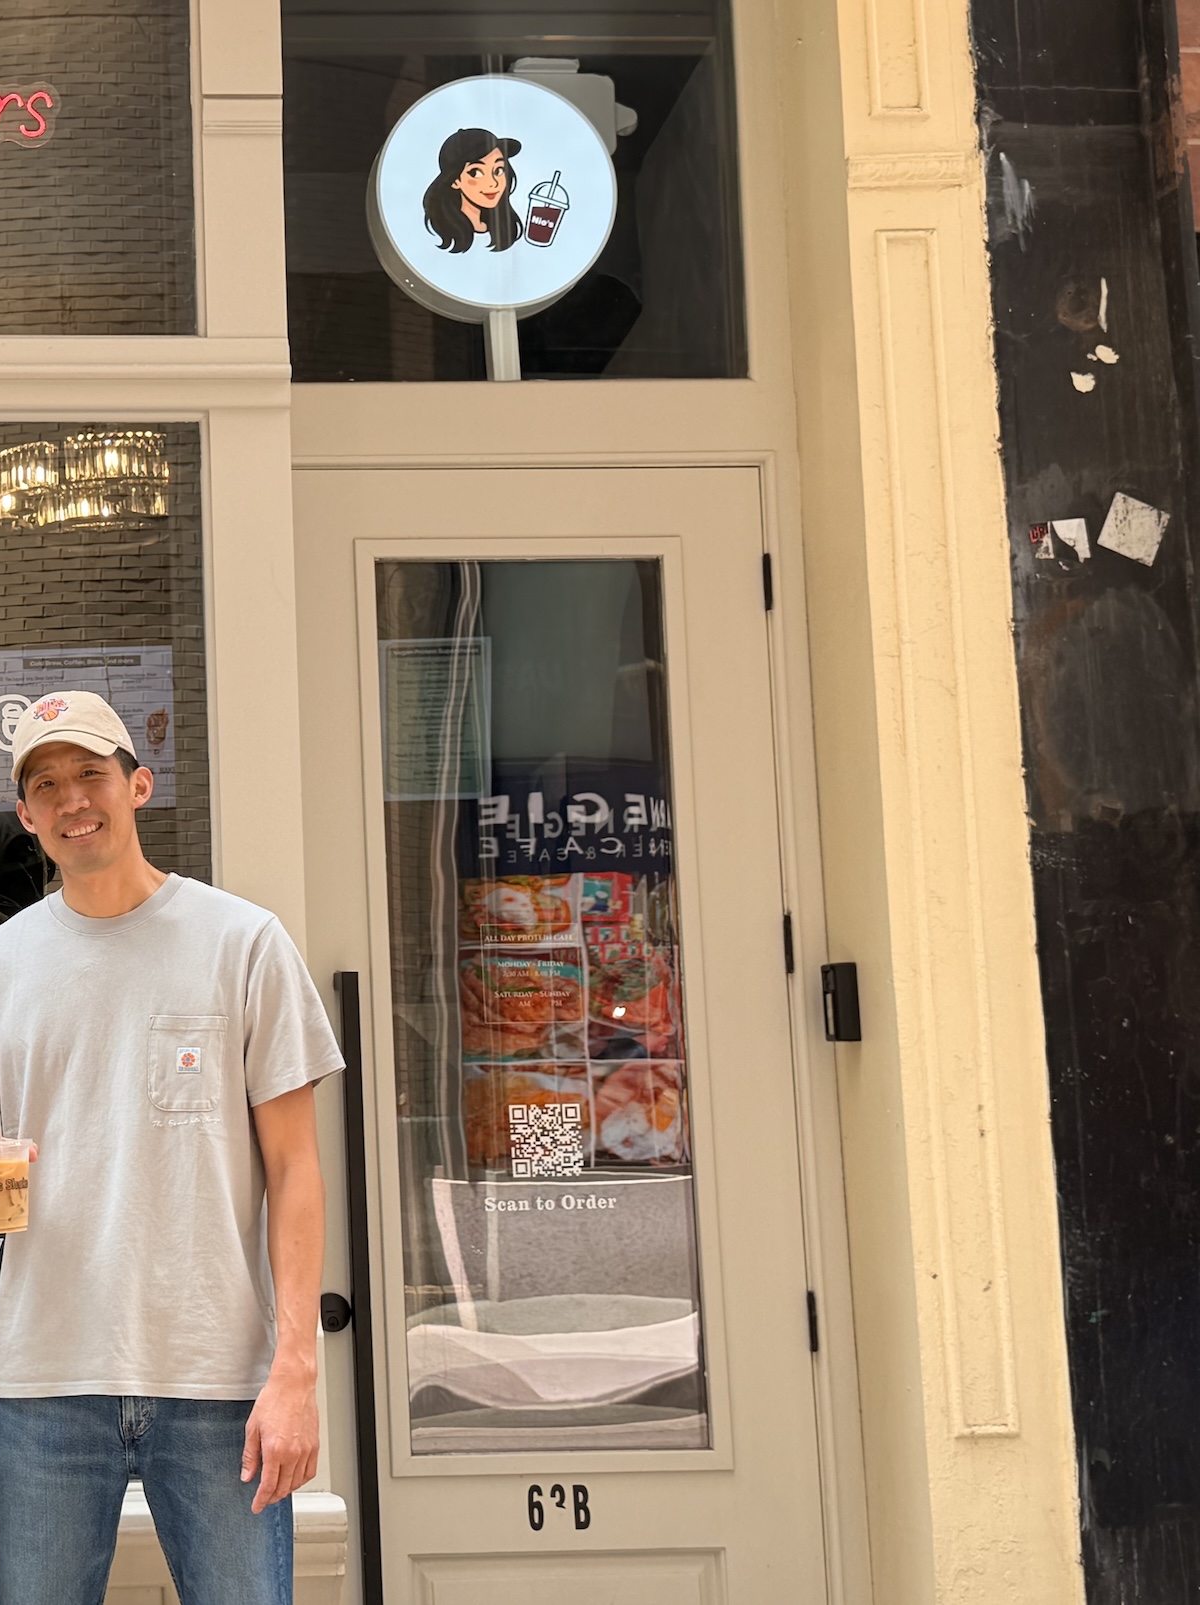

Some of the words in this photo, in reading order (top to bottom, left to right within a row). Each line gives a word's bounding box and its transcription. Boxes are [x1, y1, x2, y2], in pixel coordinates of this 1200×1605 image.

[531, 215, 555, 229] Nio's
[500, 934, 517, 942] DAY
[537, 959, 565, 967] FRIDAY
[539, 990, 571, 998] SUNDAY
[484, 1196, 531, 1212] Scan
[535, 1195, 556, 1212] to
[560, 1194, 618, 1211] Order
